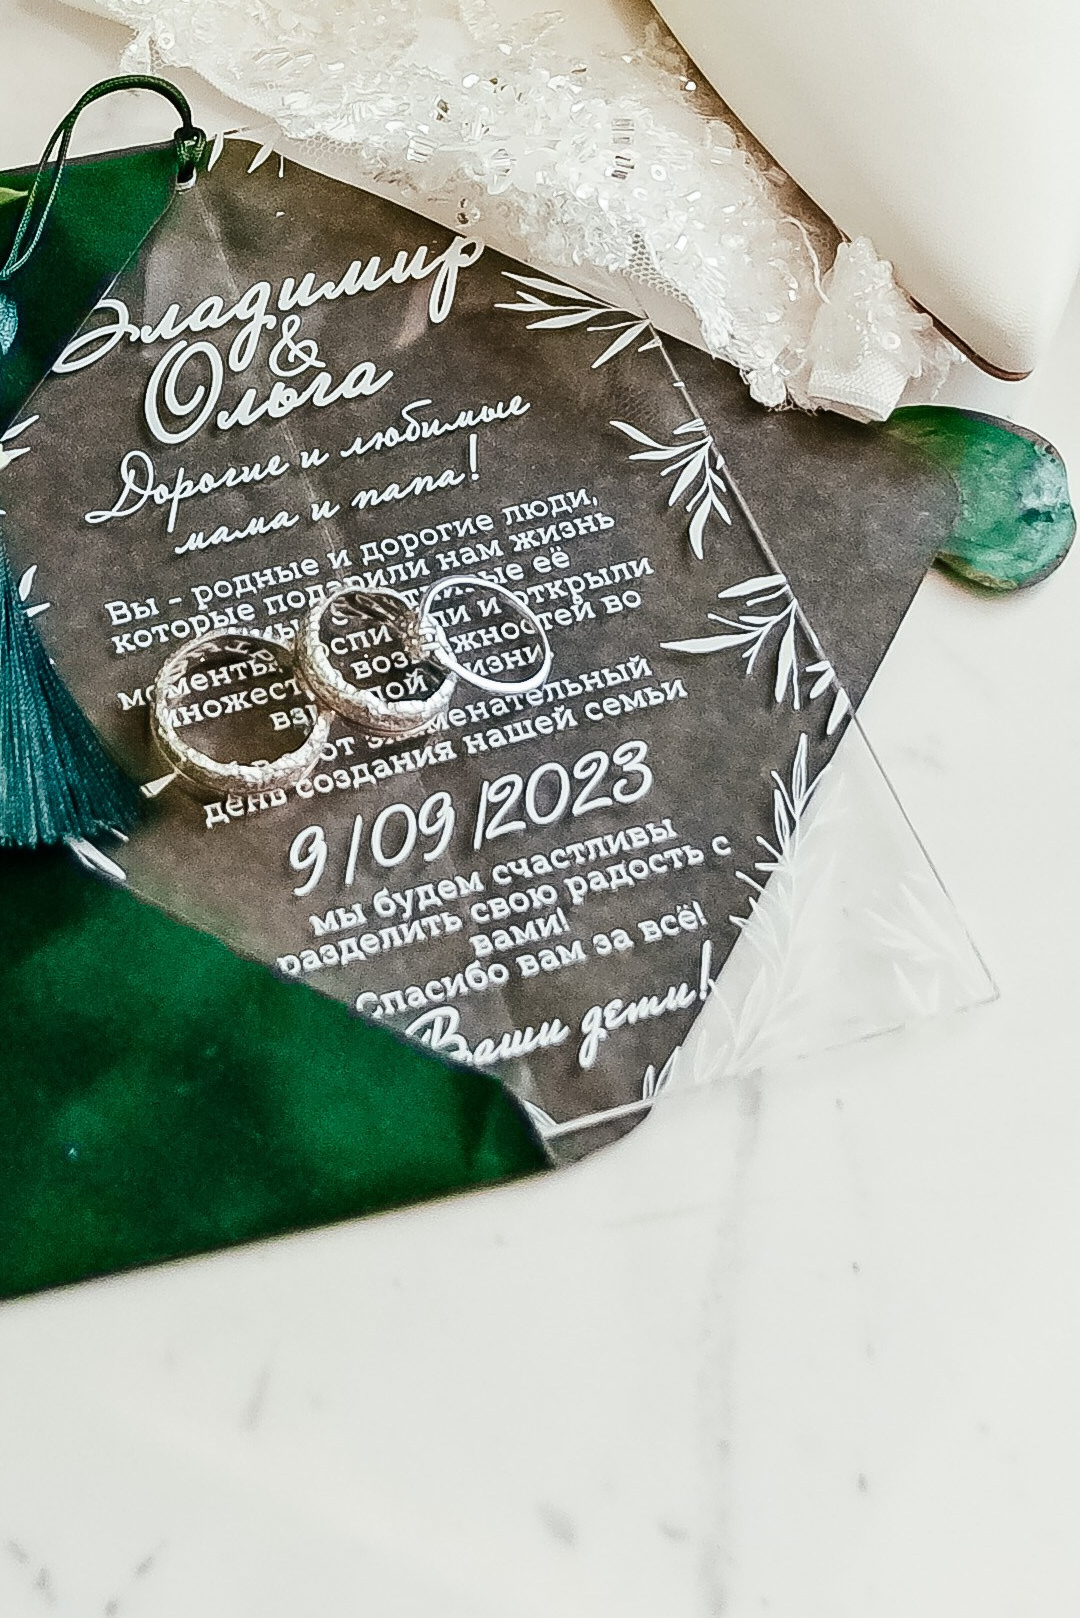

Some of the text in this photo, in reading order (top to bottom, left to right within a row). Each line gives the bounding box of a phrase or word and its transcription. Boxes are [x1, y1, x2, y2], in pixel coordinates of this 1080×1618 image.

[51, 234, 485, 374] Владимир
[269, 314, 326, 377] &
[144, 340, 394, 445] Ольга
[85, 395, 531, 534] Дорогие и любимые
[174, 433, 480, 556] мама и папа!
[104, 598, 160, 627] Вы
[191, 555, 319, 611] родные
[327, 548, 351, 570] и
[359, 510, 495, 567] дорогие
[502, 485, 601, 529] люди,
[111, 602, 257, 654] которые
[435, 539, 505, 571] нам
[509, 510, 616, 553] жизнь
[476, 596, 503, 618] и
[532, 546, 571, 573] её
[601, 590, 643, 625] во
[295, 739, 458, 800] создания
[465, 705, 579, 756] нашей
[584, 674, 690, 723] семьи
[276, 834, 734, 978] разделить свою радость с
[309, 817, 679, 937] мы будем счастливы
[469, 907, 571, 959] вами!
[356, 900, 709, 1019] Спасибо вам за всё!
[404, 938, 718, 1071] Ваши дети!
